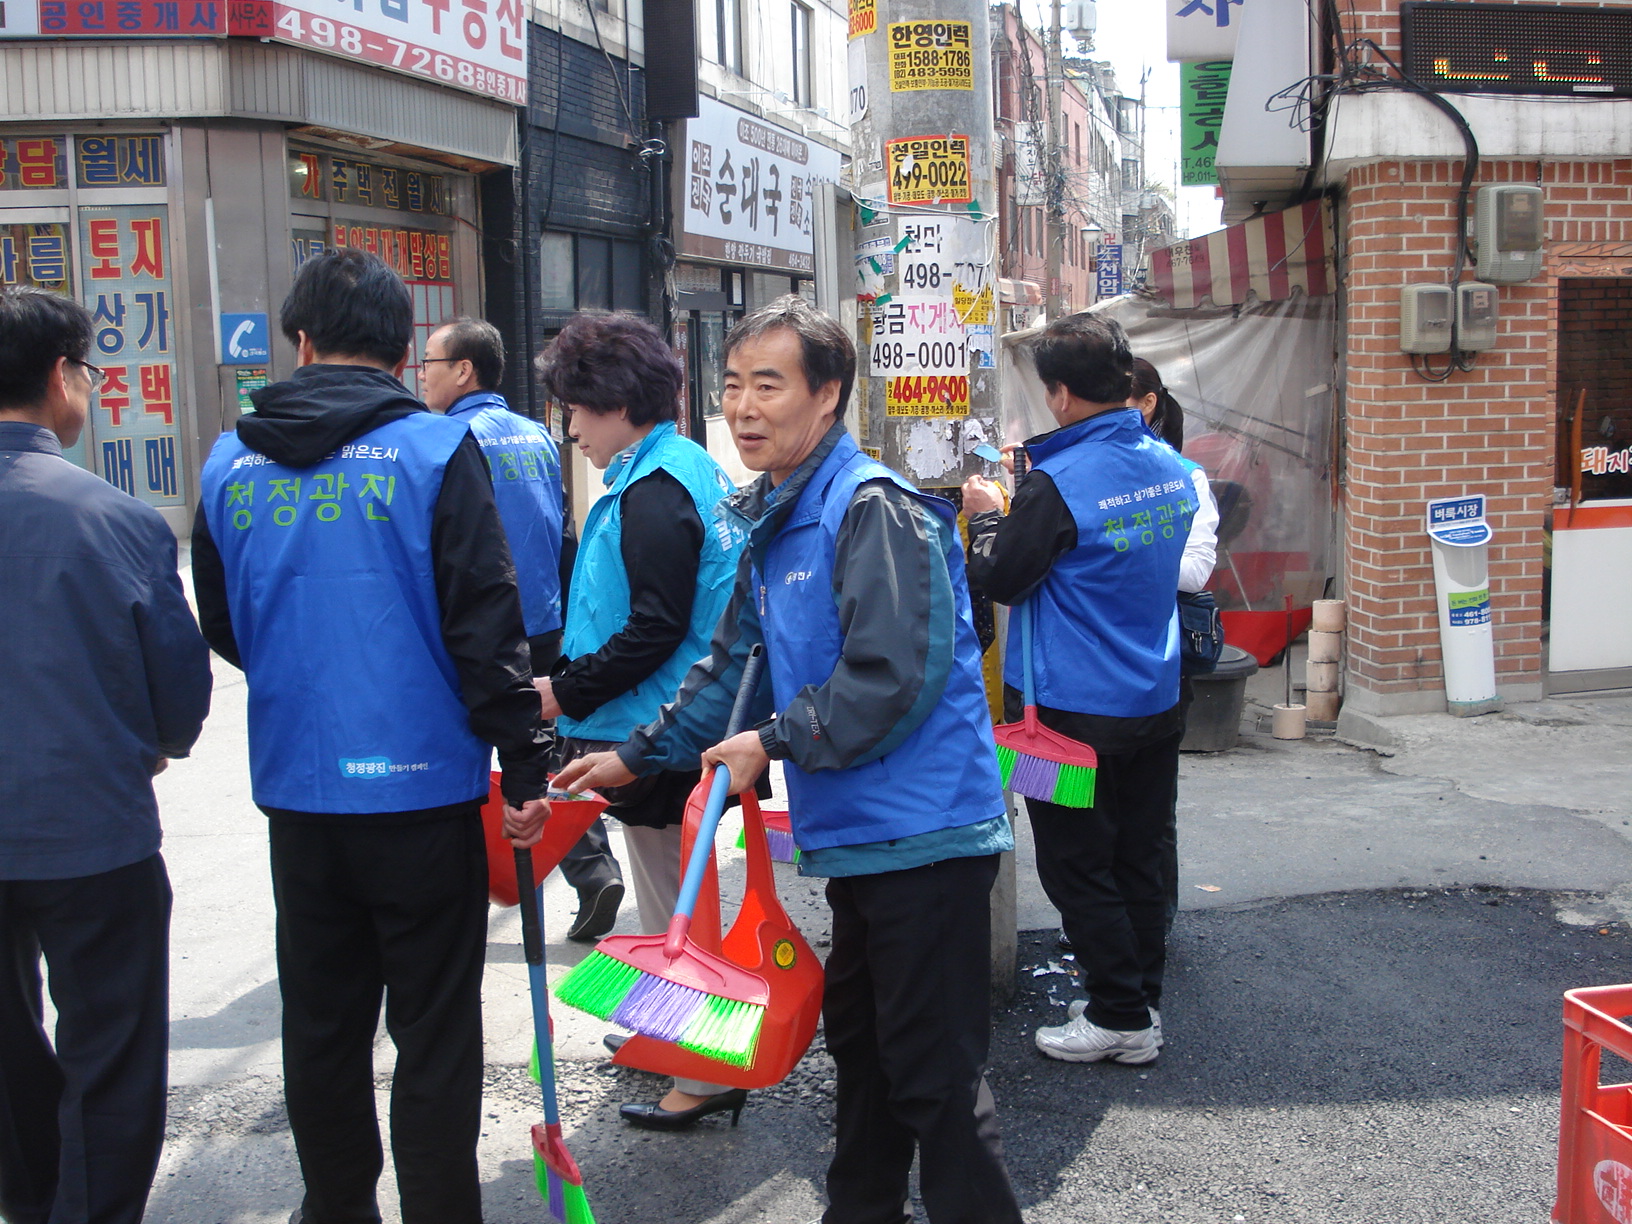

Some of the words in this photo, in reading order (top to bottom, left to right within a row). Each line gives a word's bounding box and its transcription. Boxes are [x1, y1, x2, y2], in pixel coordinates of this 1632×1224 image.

[41, 1, 217, 30] 공인중개사
[230, 4, 269, 29] 사무소
[892, 23, 970, 49] 한영인력
[277, 9, 475, 87] 498-7268
[476, 67, 526, 103] 공인중개사
[80, 136, 163, 185] 월세
[891, 140, 966, 162] 성일인력
[715, 148, 783, 237] 순대국
[89, 217, 165, 280] 토지
[93, 290, 170, 355] 상가
[872, 341, 966, 370] 498-0001
[100, 363, 174, 427] 주택
[101, 436, 179, 499] 매매
[341, 444, 399, 461] 맑은도시
[1581, 446, 1632, 475] 돼지
[226, 472, 397, 531] 청정광진
[1098, 494, 1133, 510] 쾌적하고
[1134, 484, 1162, 502] 살기좋은
[1434, 504, 1479, 521] 벼룩시장
[1103, 498, 1193, 553] 청정광진
[346, 762, 386, 774] 청정광진
